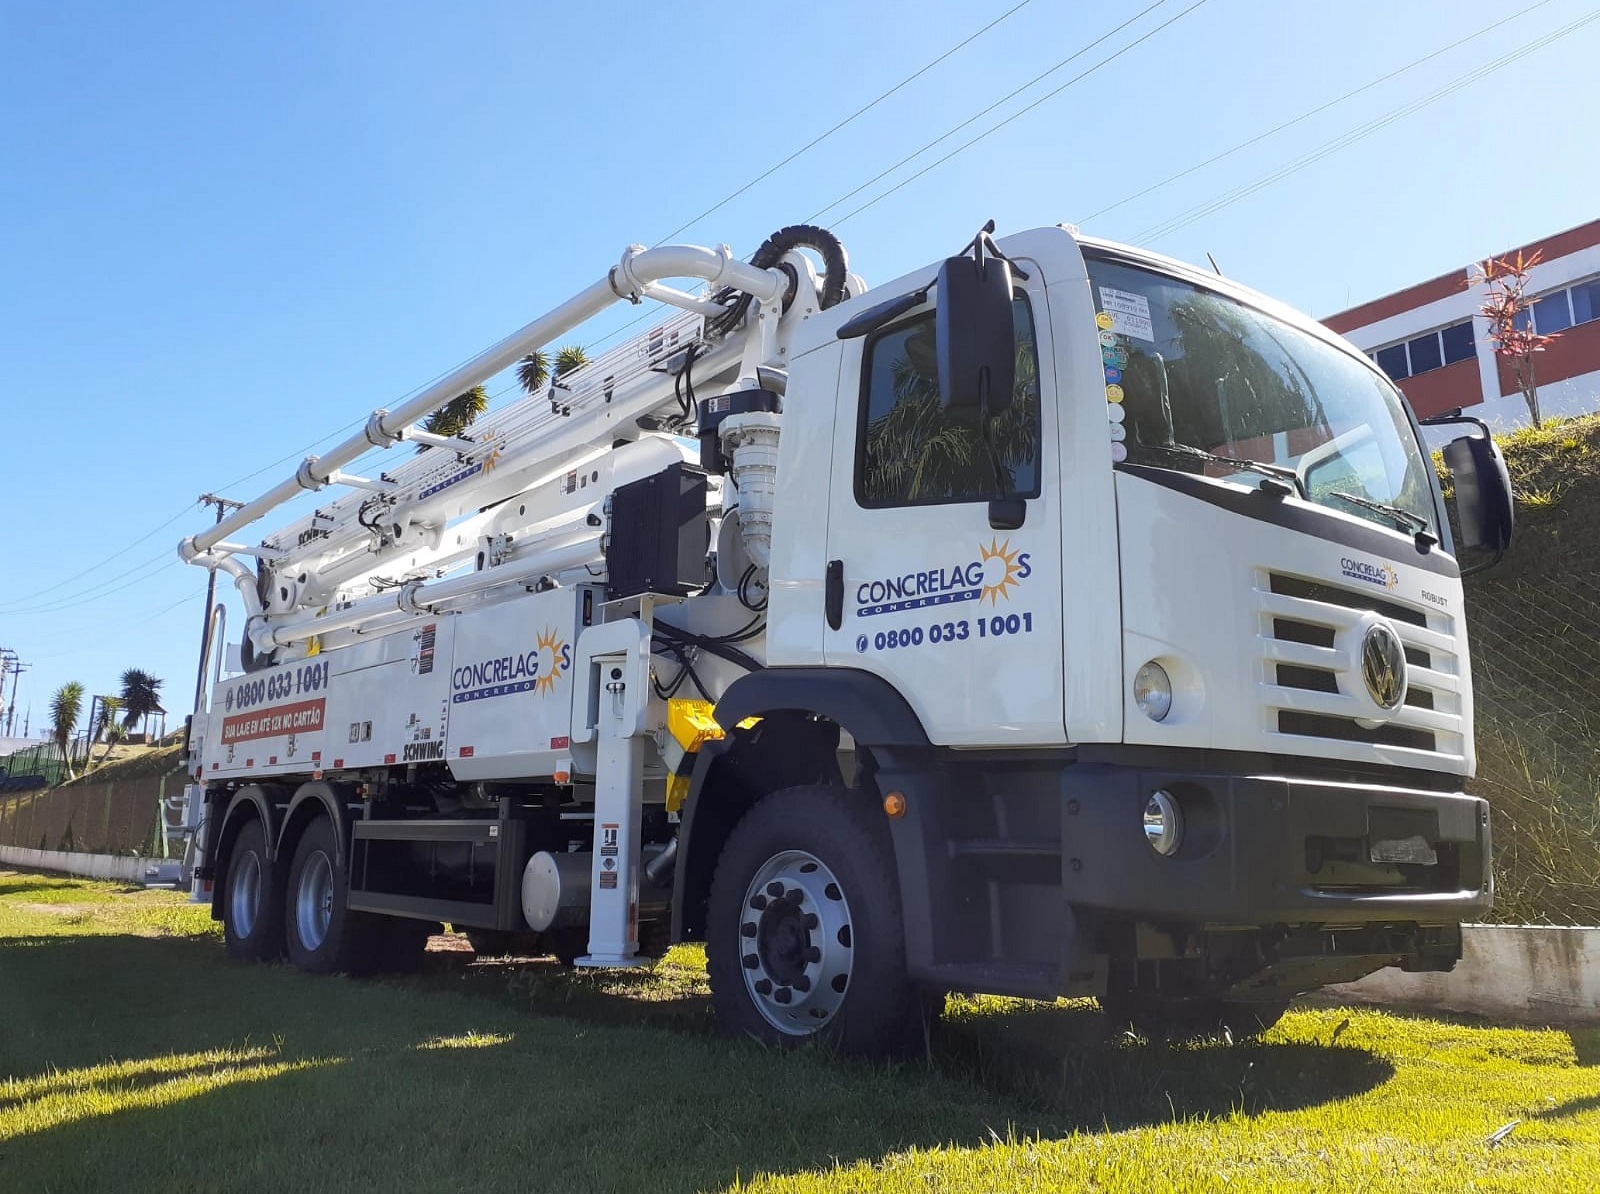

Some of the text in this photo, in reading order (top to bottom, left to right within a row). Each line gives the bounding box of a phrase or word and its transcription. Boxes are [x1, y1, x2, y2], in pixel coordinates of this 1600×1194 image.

[861, 591, 973, 616] CONCRETO
[1421, 590, 1447, 606] ROBUST
[874, 612, 1032, 651] 0800 033 1001
[236, 661, 329, 710] 0800 033 1001
[455, 682, 531, 701] CONCRETO
[224, 724, 236, 738] SUA
[236, 721, 250, 737] LAJE
[259, 714, 271, 733] ATÉ
[271, 714, 282, 731] 12X
[282, 713, 292, 730] NO
[293, 706, 320, 728] CARTÃO
[403, 740, 443, 761] SCHWING
